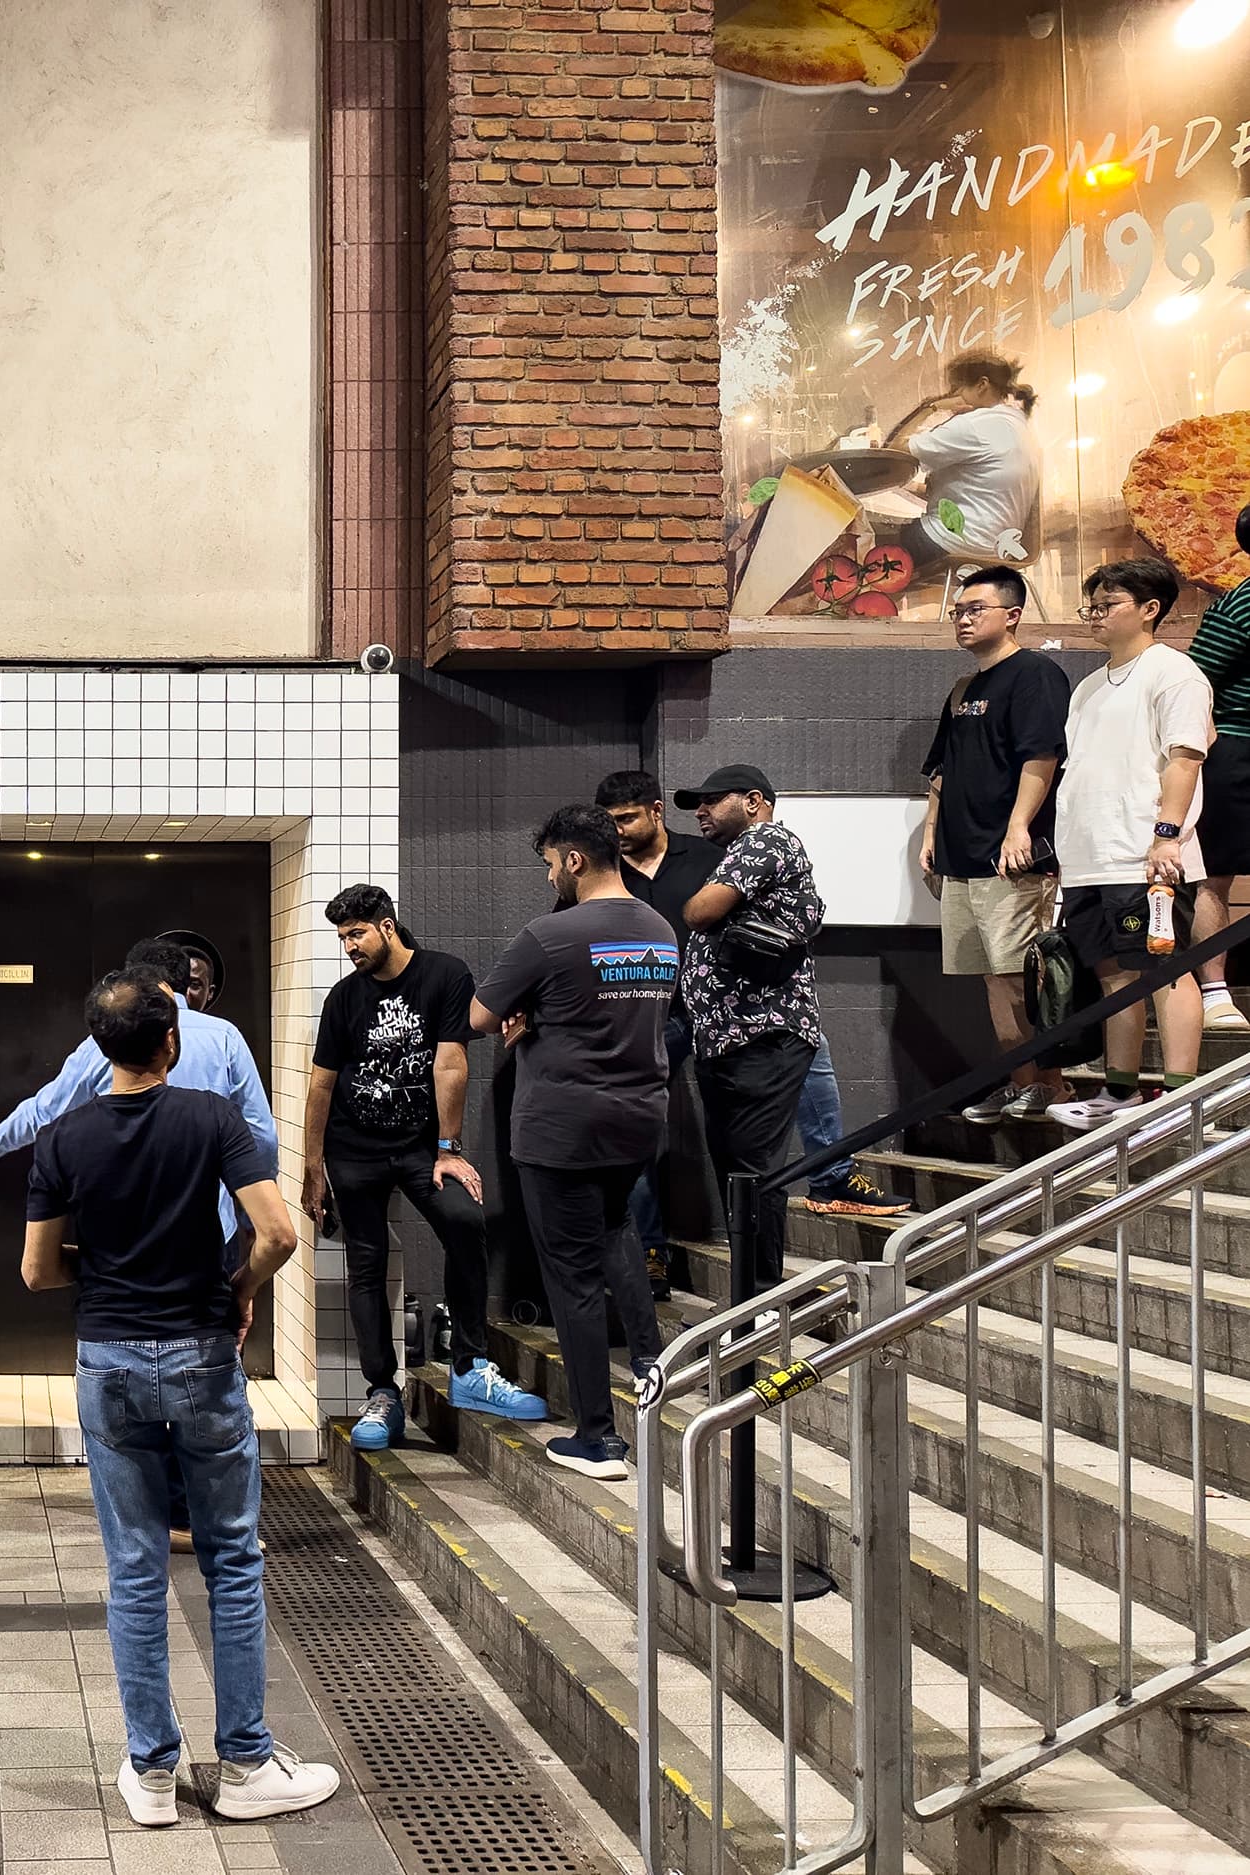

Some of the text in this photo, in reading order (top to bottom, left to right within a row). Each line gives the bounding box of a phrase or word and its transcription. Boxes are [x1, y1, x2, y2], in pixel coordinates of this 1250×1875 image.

[845, 246, 1025, 324] FRESH
[851, 299, 1027, 369] SINCE
[601, 966, 651, 982] VENTURA
[598, 989, 618, 1000] save
[619, 990, 632, 998] our
[632, 988, 656, 998] home
[379, 995, 405, 1011] THE
